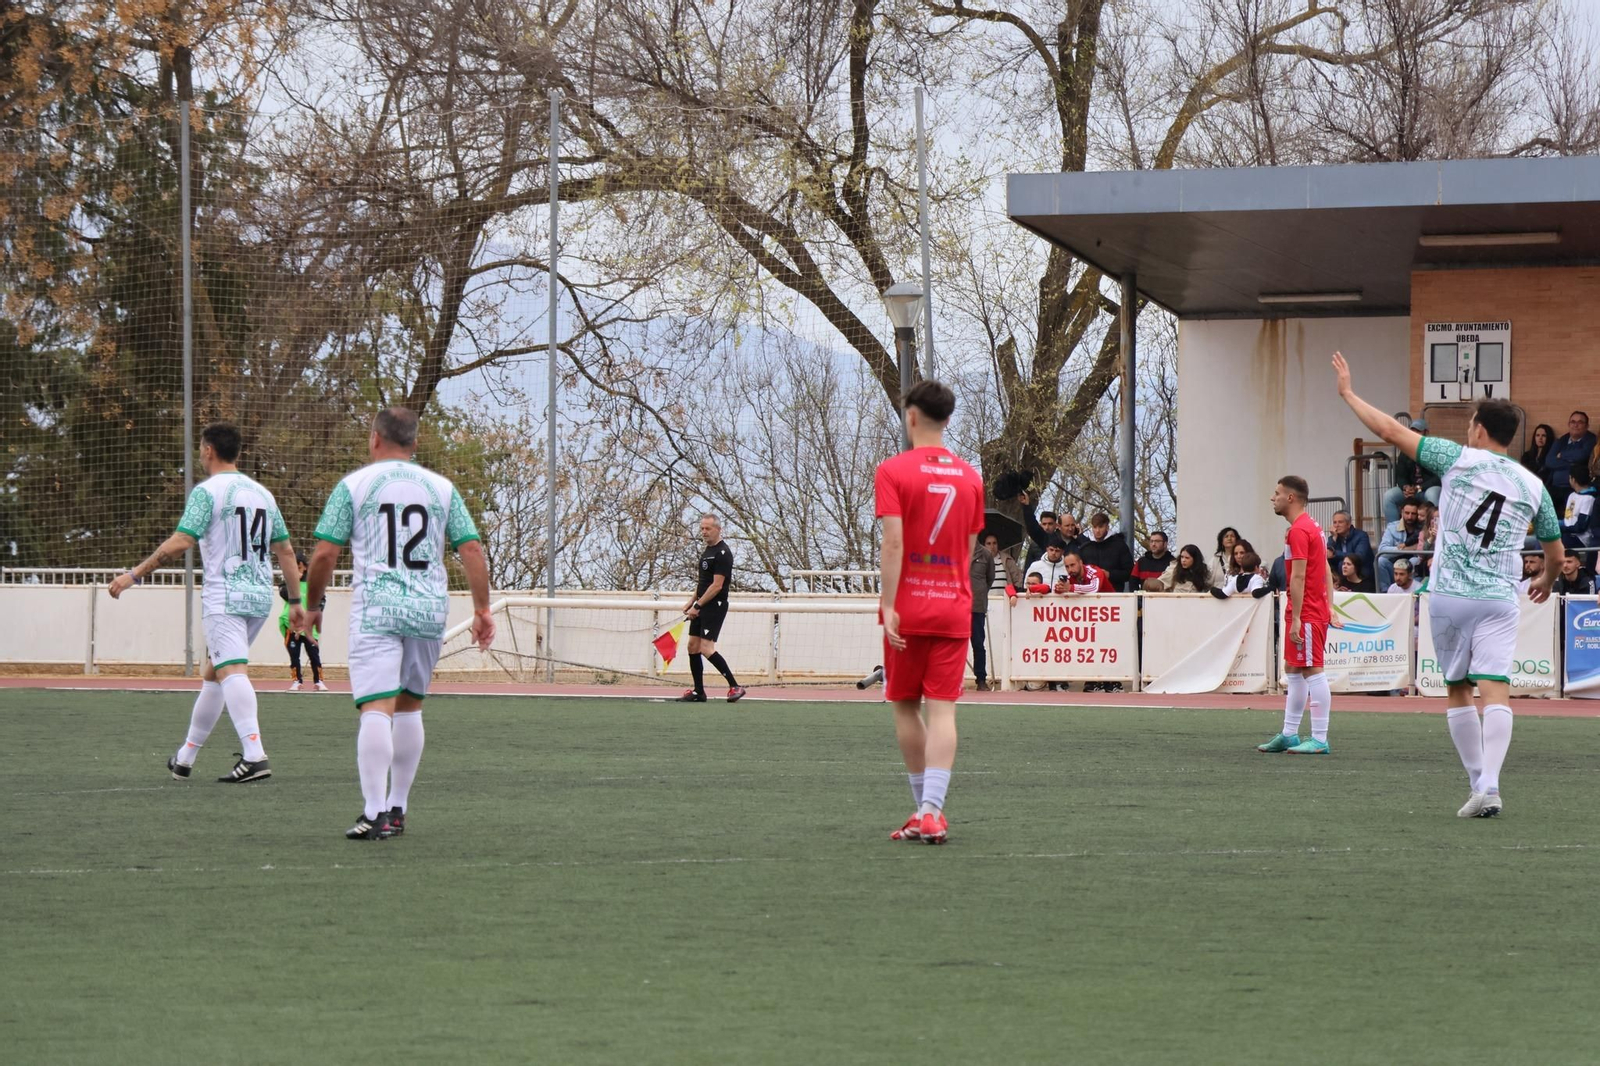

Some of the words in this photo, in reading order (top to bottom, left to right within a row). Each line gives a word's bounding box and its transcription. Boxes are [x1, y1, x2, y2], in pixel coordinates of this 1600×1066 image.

[1428, 324, 1454, 332] EXCMO.
[1455, 322, 1509, 331] AYUNTAMIENTO
[1456, 333, 1479, 342] ÚBEDA
[1440, 384, 1447, 399] L
[1484, 384, 1493, 398] V
[928, 483, 956, 545] 7
[1465, 491, 1506, 550] 4
[235, 506, 267, 562] 14
[378, 503, 430, 570] 12
[927, 589, 957, 600] familia
[382, 607, 404, 617] PARA
[406, 610, 436, 622] ESPAÑA
[1033, 602, 1120, 622] NÚNCIESE
[1044, 623, 1096, 643] AQUÍ
[1022, 648, 1049, 663] 615
[1054, 648, 1071, 663] 88
[1077, 648, 1094, 663] 52
[1100, 648, 1117, 663] 79
[1363, 655, 1378, 664] 678
[1380, 654, 1393, 663] 093
[1395, 654, 1407, 662] 560
